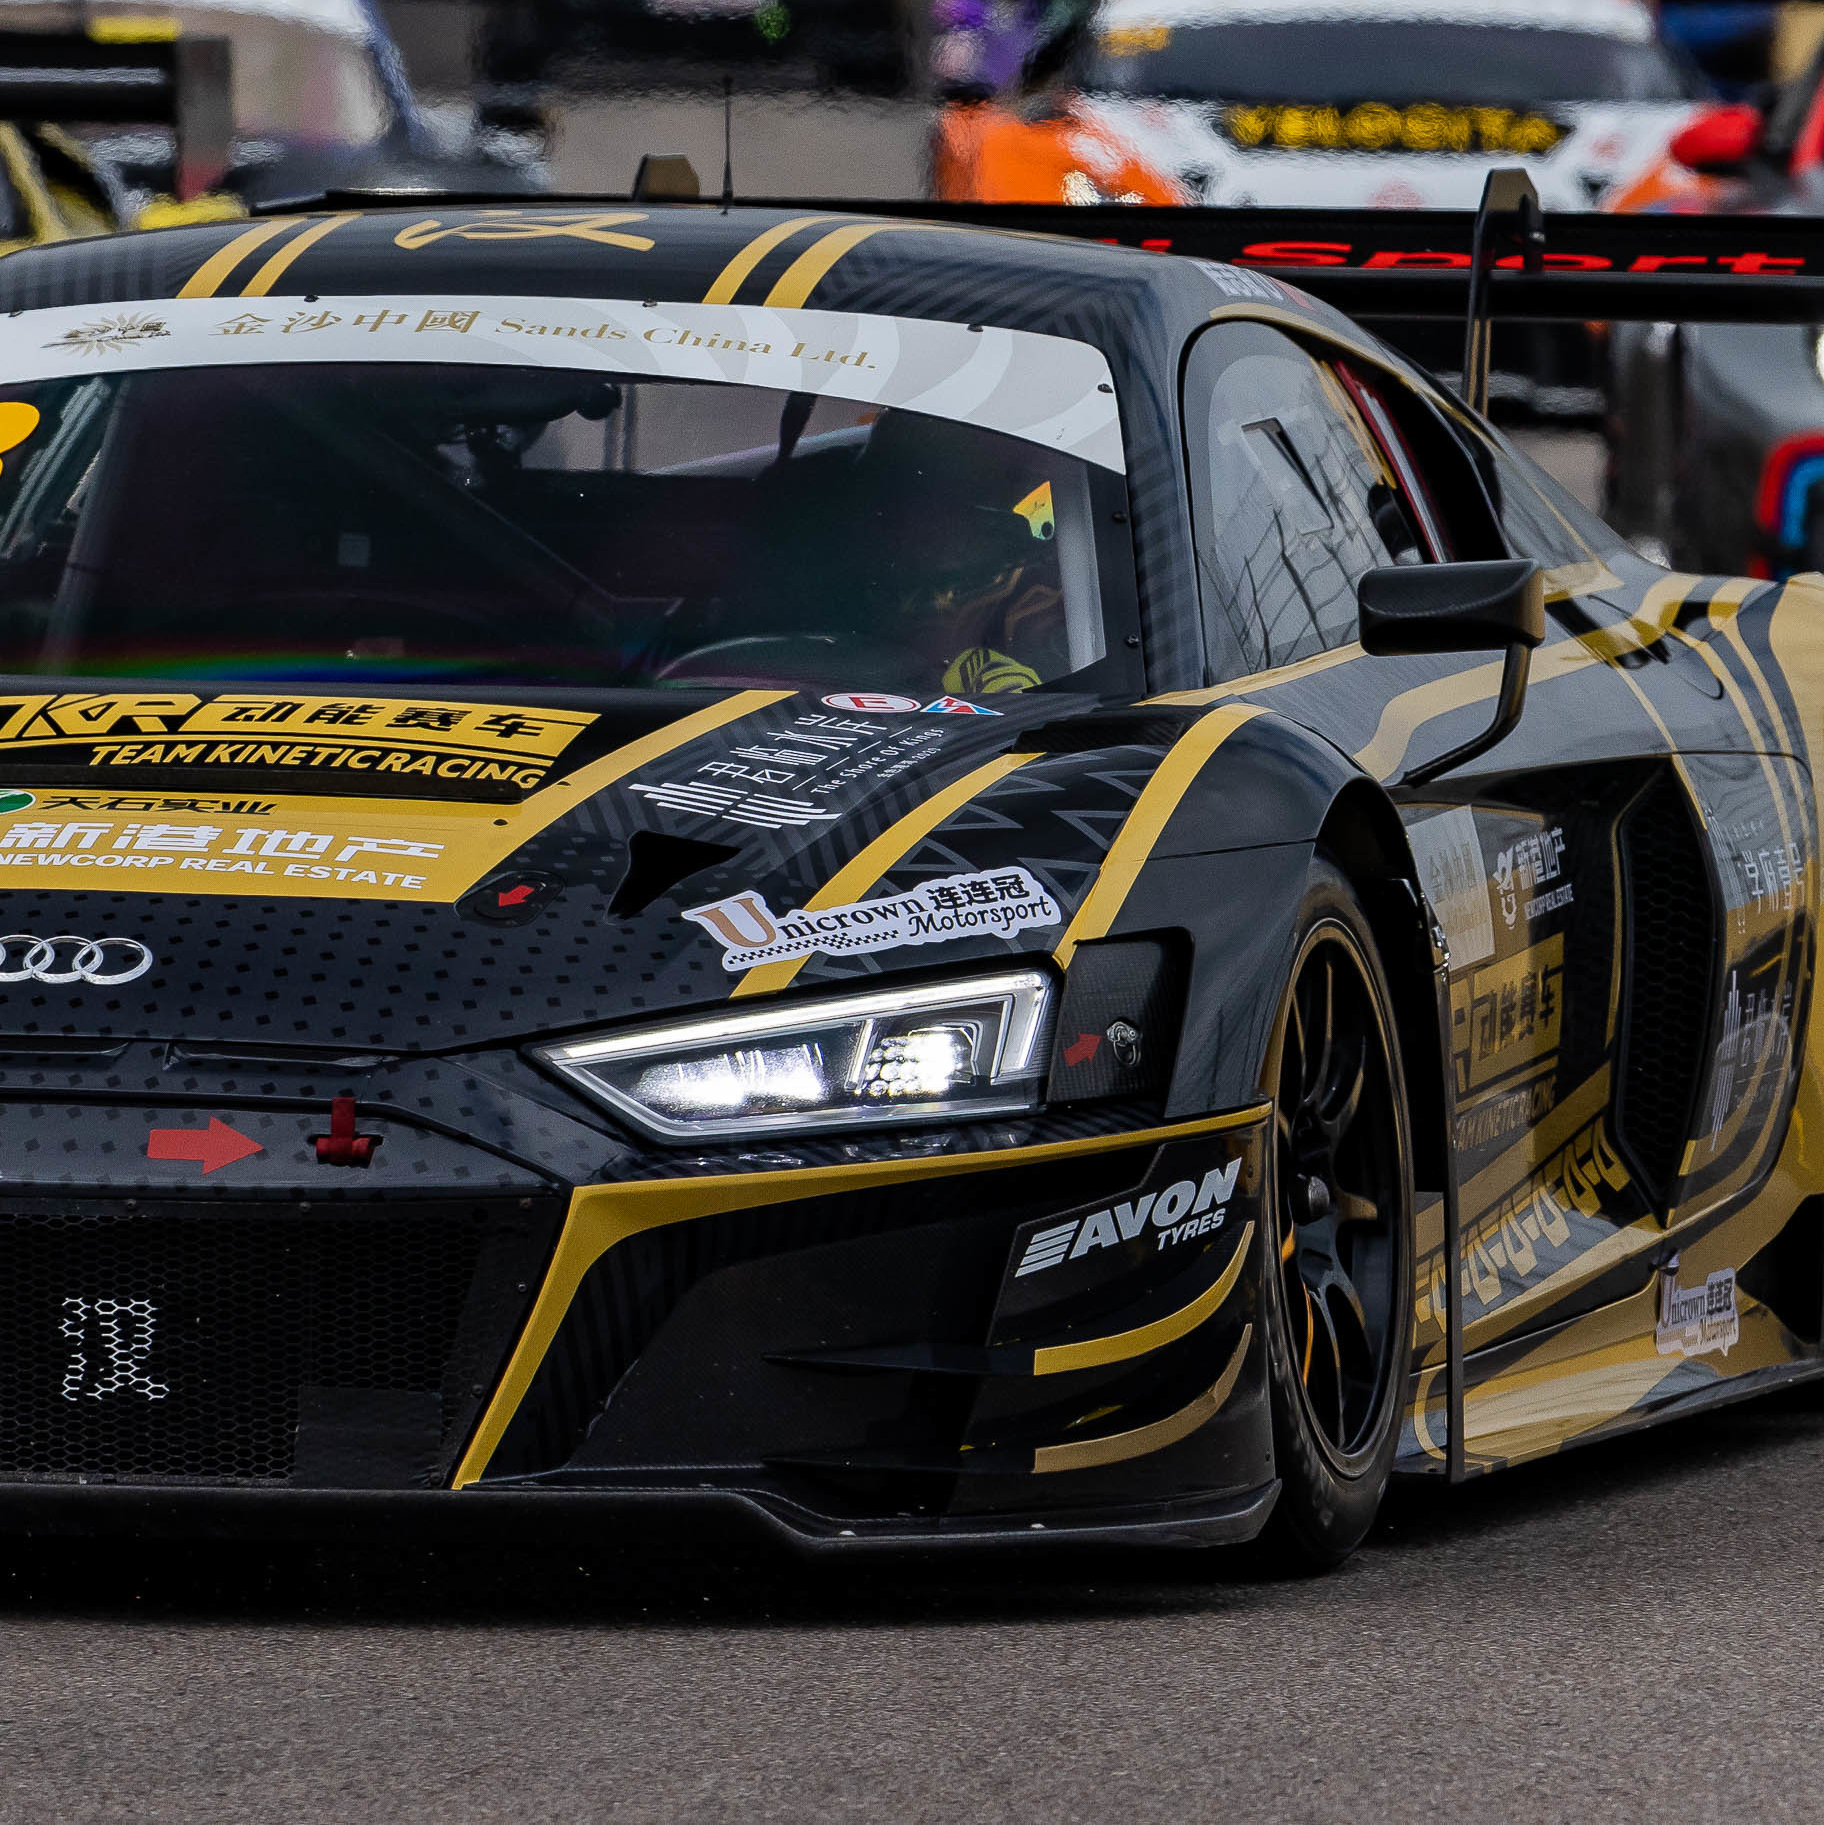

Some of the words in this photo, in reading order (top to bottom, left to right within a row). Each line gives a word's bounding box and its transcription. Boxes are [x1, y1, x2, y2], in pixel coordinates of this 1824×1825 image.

[208, 309, 483, 336] 金沙中國
[495, 317, 628, 342] Sands
[643, 326, 772, 356] China
[788, 341, 878, 370] Ltd.
[222, 698, 551, 742] 动能赛车
[88, 743, 207, 767] TEAM
[202, 742, 383, 771] KINETIC
[375, 751, 548, 791] RACING
[811, 778, 846, 795] The
[839, 755, 885, 779] Shore
[899, 727, 945, 747] Kings
[37, 794, 281, 816] 天石实业
[177, 856, 275, 877] REAL
[281, 863, 430, 891] ESTATE
[694, 896, 929, 949] Unicrown
[926, 873, 1031, 912] 连连冠
[908, 895, 1053, 938] Motorsport
[1069, 1157, 1243, 1260] AVON
[1158, 1207, 1227, 1252] TYRES
